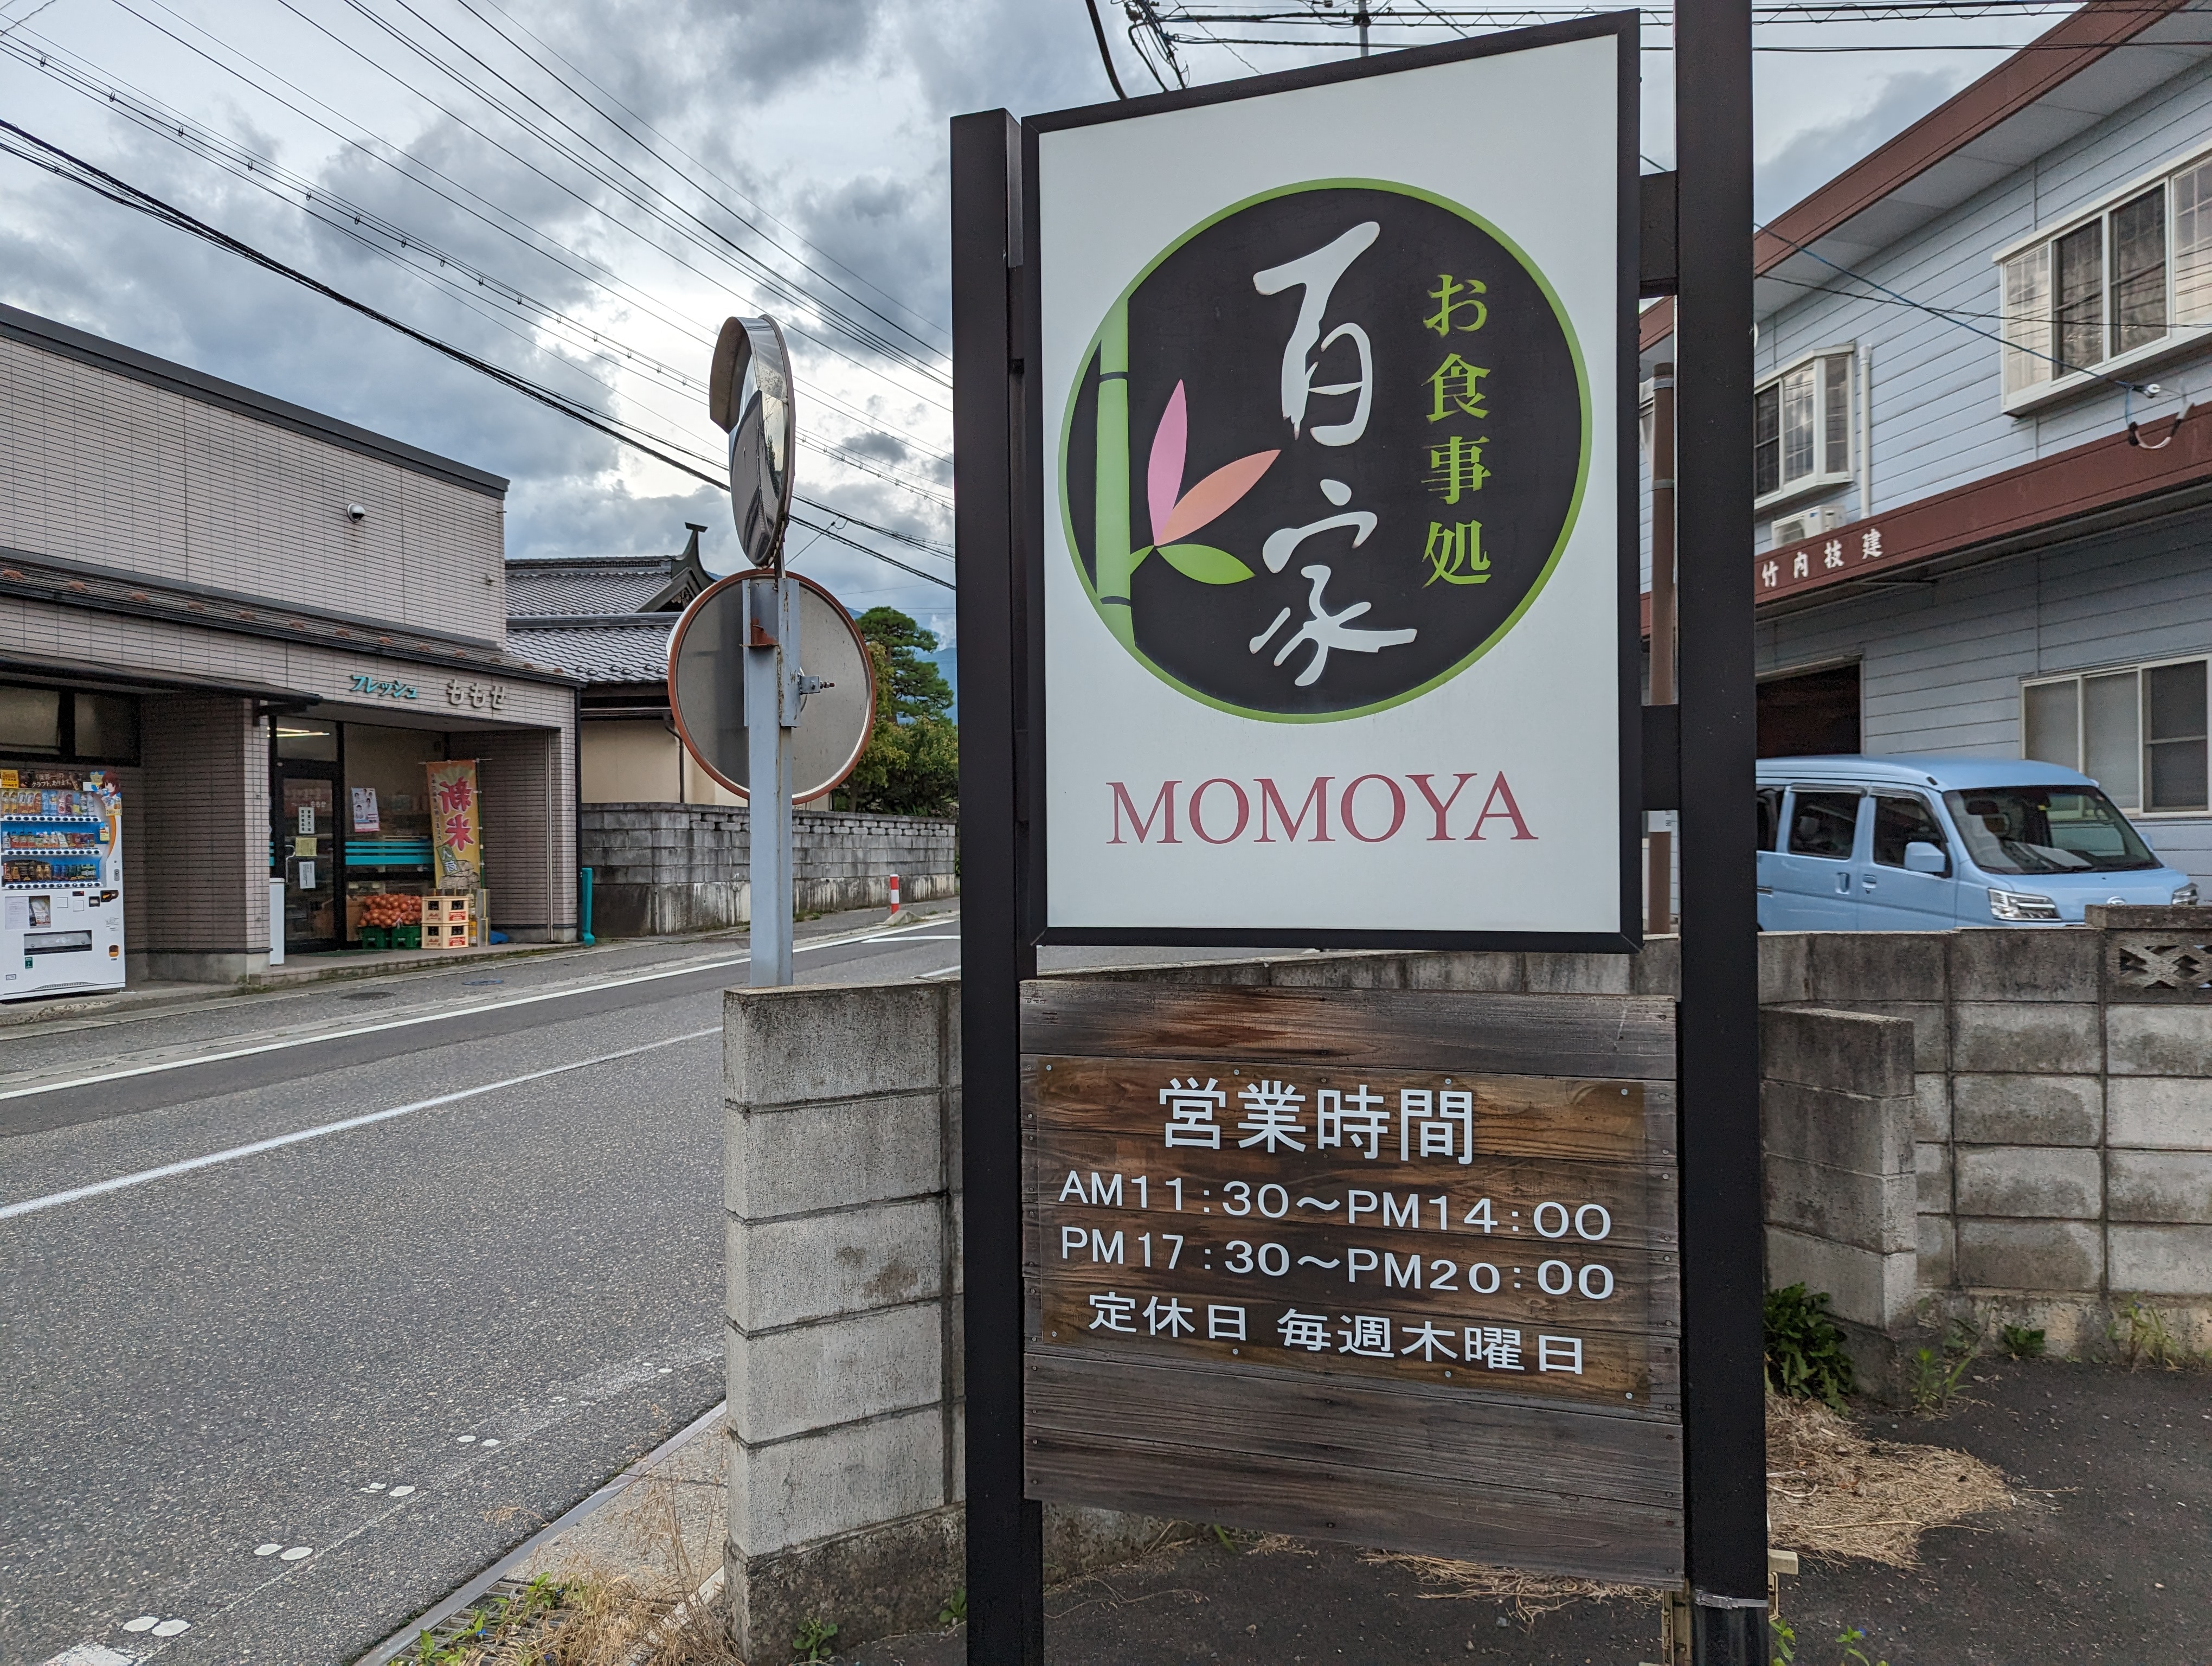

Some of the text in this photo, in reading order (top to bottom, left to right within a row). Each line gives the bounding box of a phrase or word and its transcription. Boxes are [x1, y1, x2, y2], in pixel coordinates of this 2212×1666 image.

[1249, 221, 1417, 687] 百家
[1422, 274, 1491, 588] お食事処
[350, 675, 506, 709] フレッシュ ももせ
[1105, 771, 1538, 844] MOMOYA
[1159, 1077, 1473, 1165] 営業時間
[1088, 1291, 1583, 1375] 定休日 毎週木曜日
